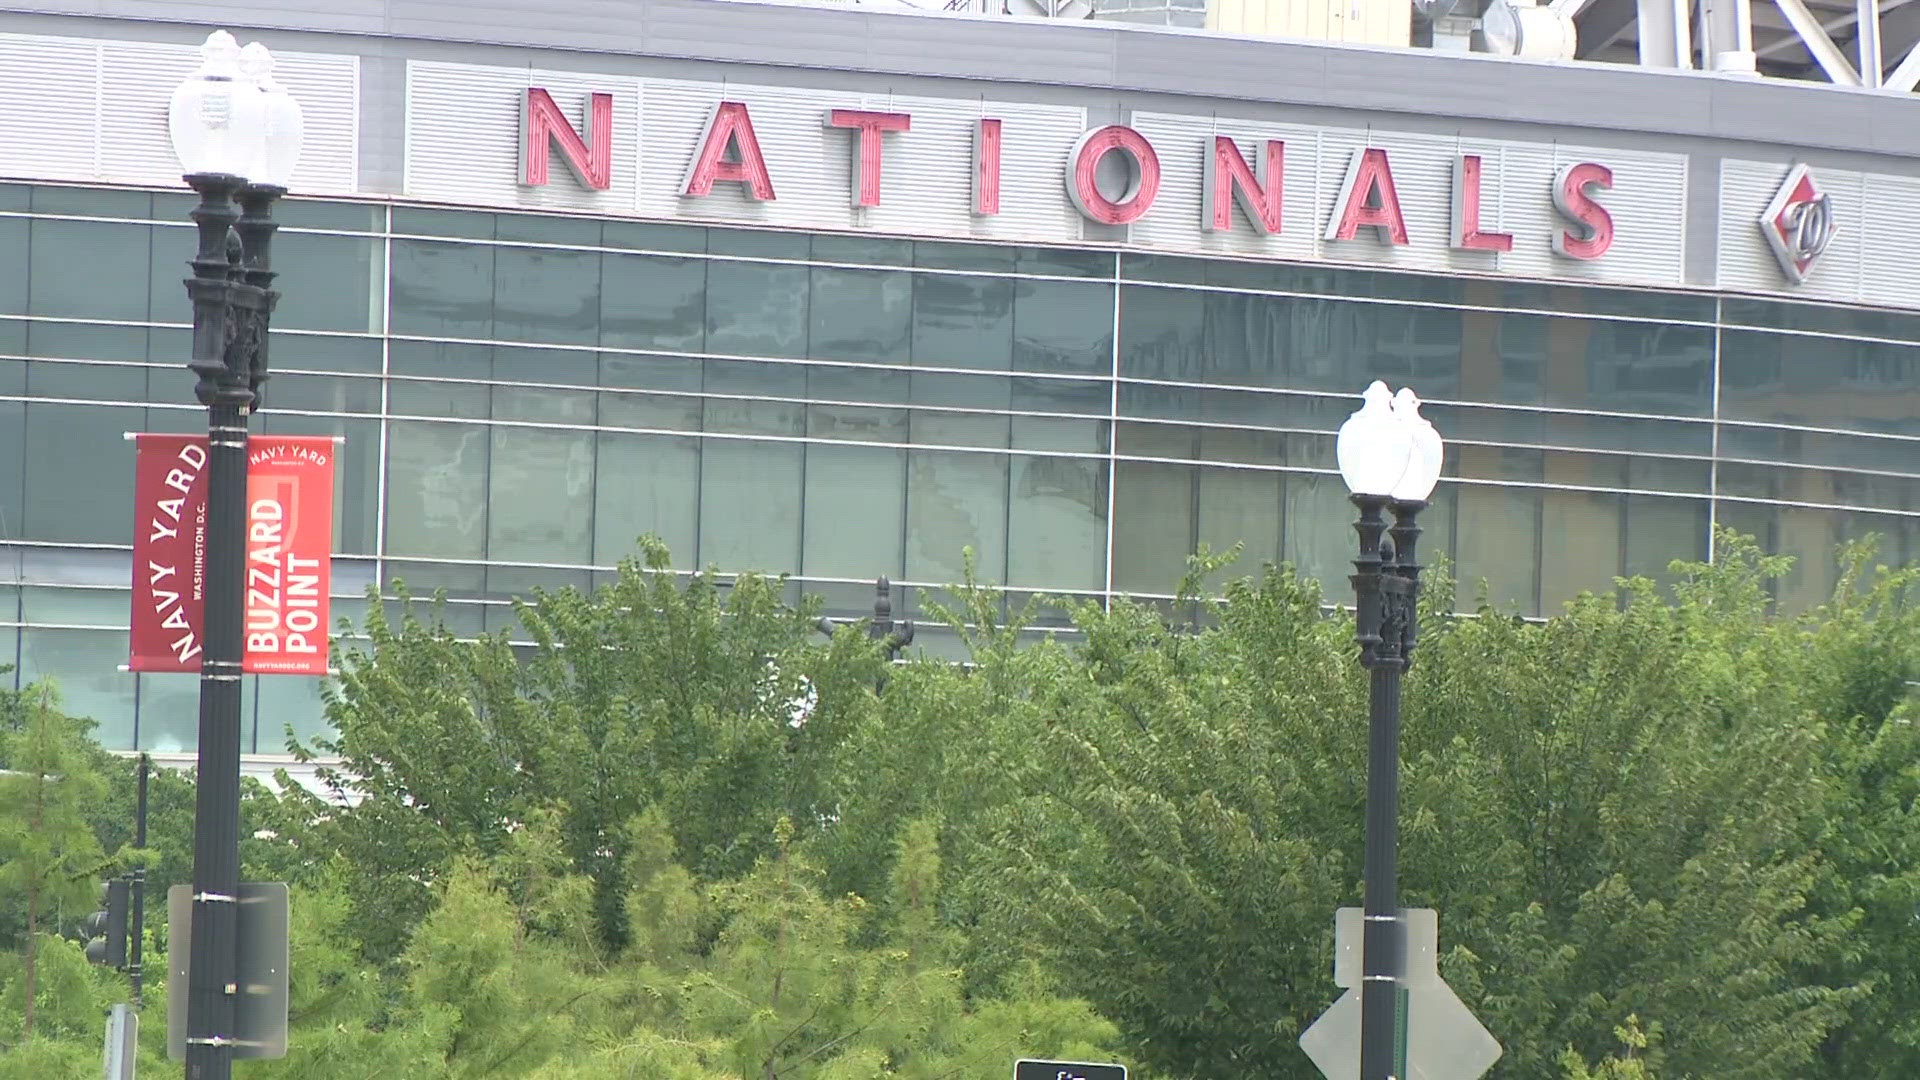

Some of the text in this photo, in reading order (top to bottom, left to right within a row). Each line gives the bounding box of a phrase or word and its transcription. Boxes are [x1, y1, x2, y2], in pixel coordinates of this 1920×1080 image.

[518, 87, 1614, 260] NATIONALS
[249, 445, 327, 466] NAVY YARD
[149, 443, 207, 664] NAVY YARD
[193, 502, 206, 601] WASHINGTON D.C.
[247, 498, 283, 654] BUZZARD
[285, 553, 320, 654] POINT
